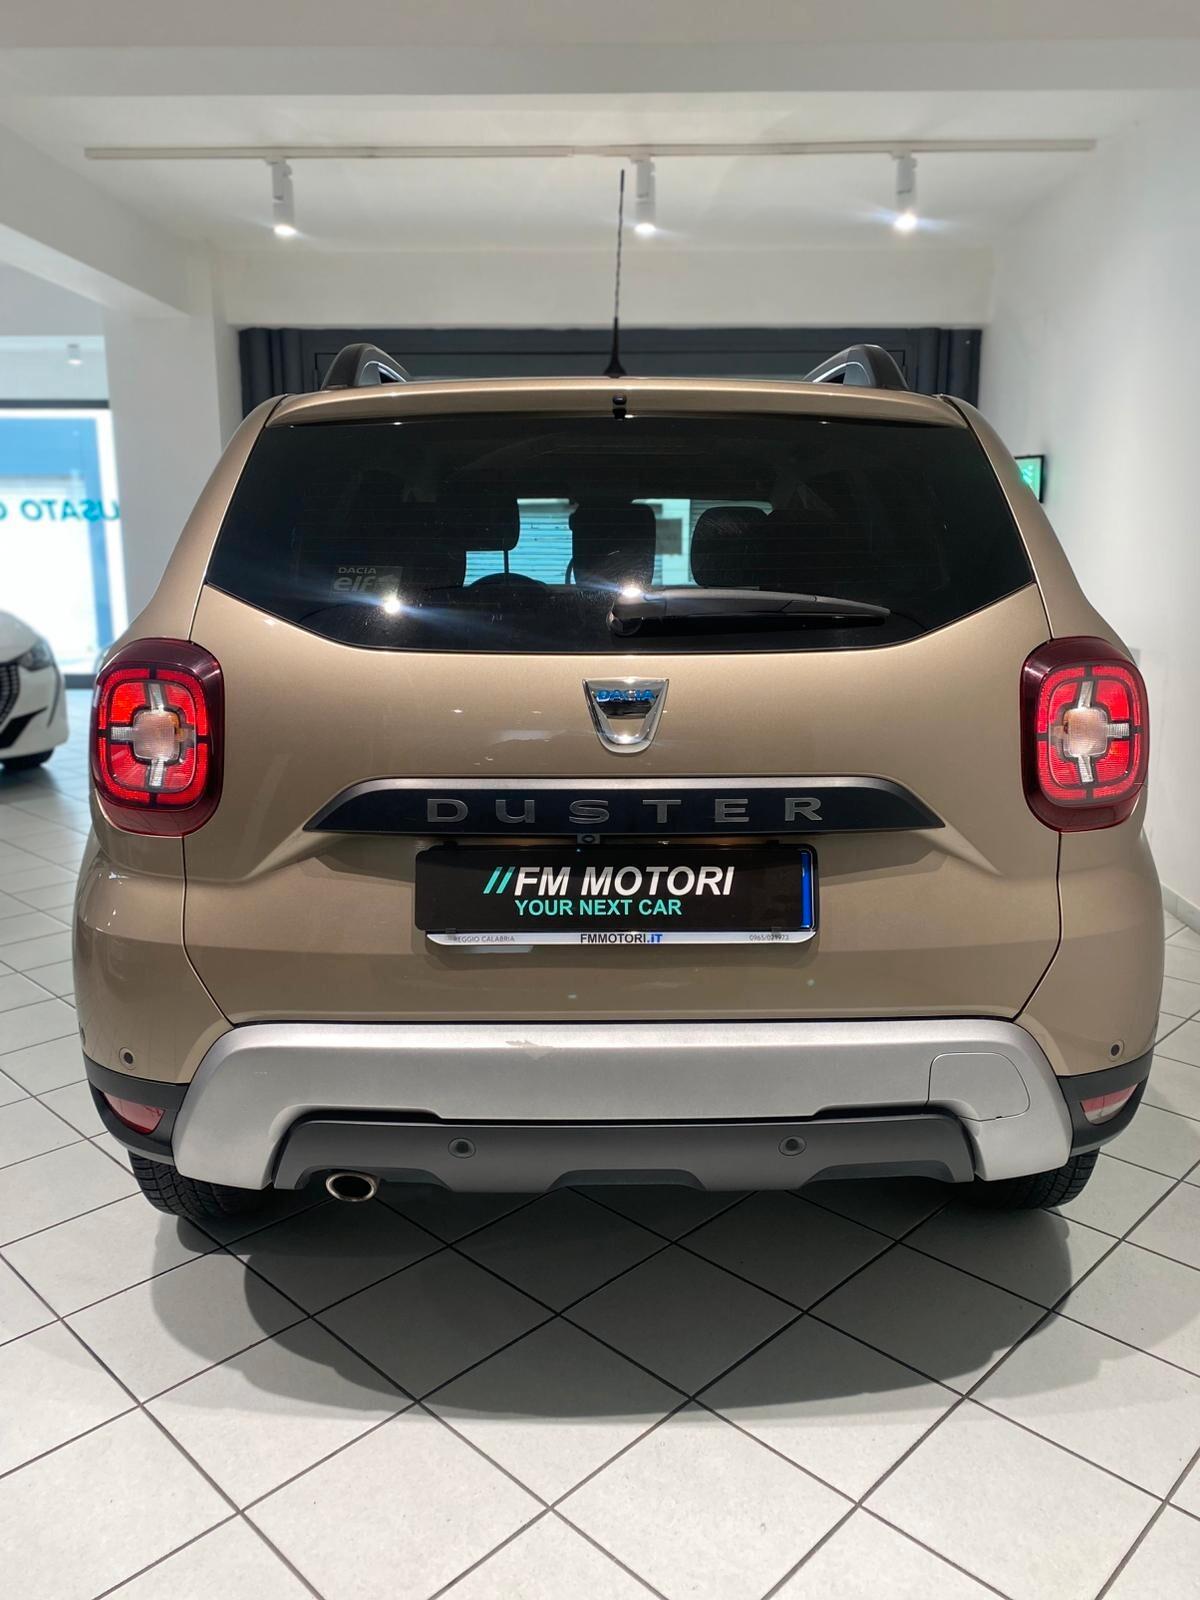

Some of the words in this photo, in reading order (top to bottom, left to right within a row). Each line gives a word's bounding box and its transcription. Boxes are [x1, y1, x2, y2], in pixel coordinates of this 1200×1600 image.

[333, 576, 377, 592] elf
[427, 797, 823, 823] DUSTER
[581, 866, 736, 897] MOTORI
[514, 900, 574, 916] YOUR
[579, 900, 633, 915] NEXT
[638, 900, 683, 915] CAR
[481, 935, 516, 943] CALABRIA
[580, 933, 663, 944] FMMOTORI.IT
